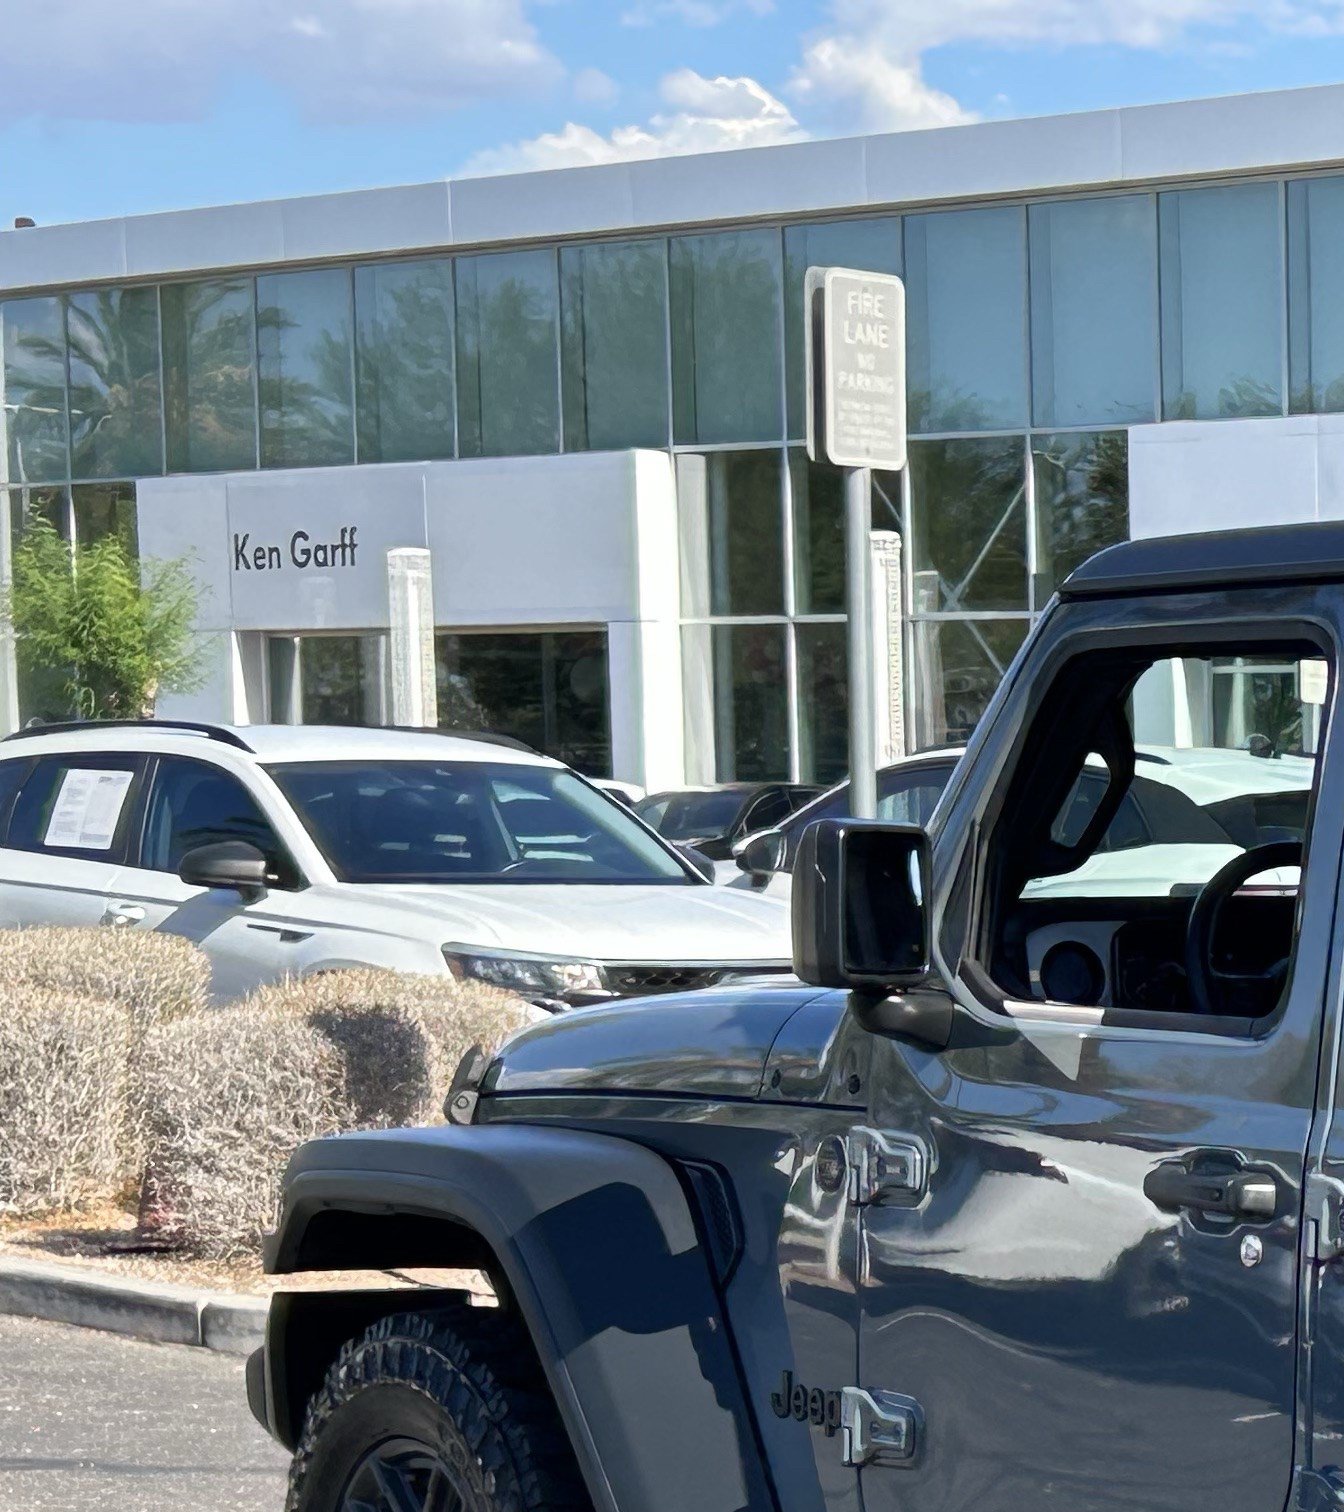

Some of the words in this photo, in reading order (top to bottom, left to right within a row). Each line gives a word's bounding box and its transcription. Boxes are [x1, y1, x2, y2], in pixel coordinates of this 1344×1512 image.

[847, 290, 885, 318] FIRE
[843, 320, 890, 348] LANE
[233, 532, 282, 571] Ken
[290, 526, 358, 569] Garff
[771, 1369, 842, 1437] Jeep
